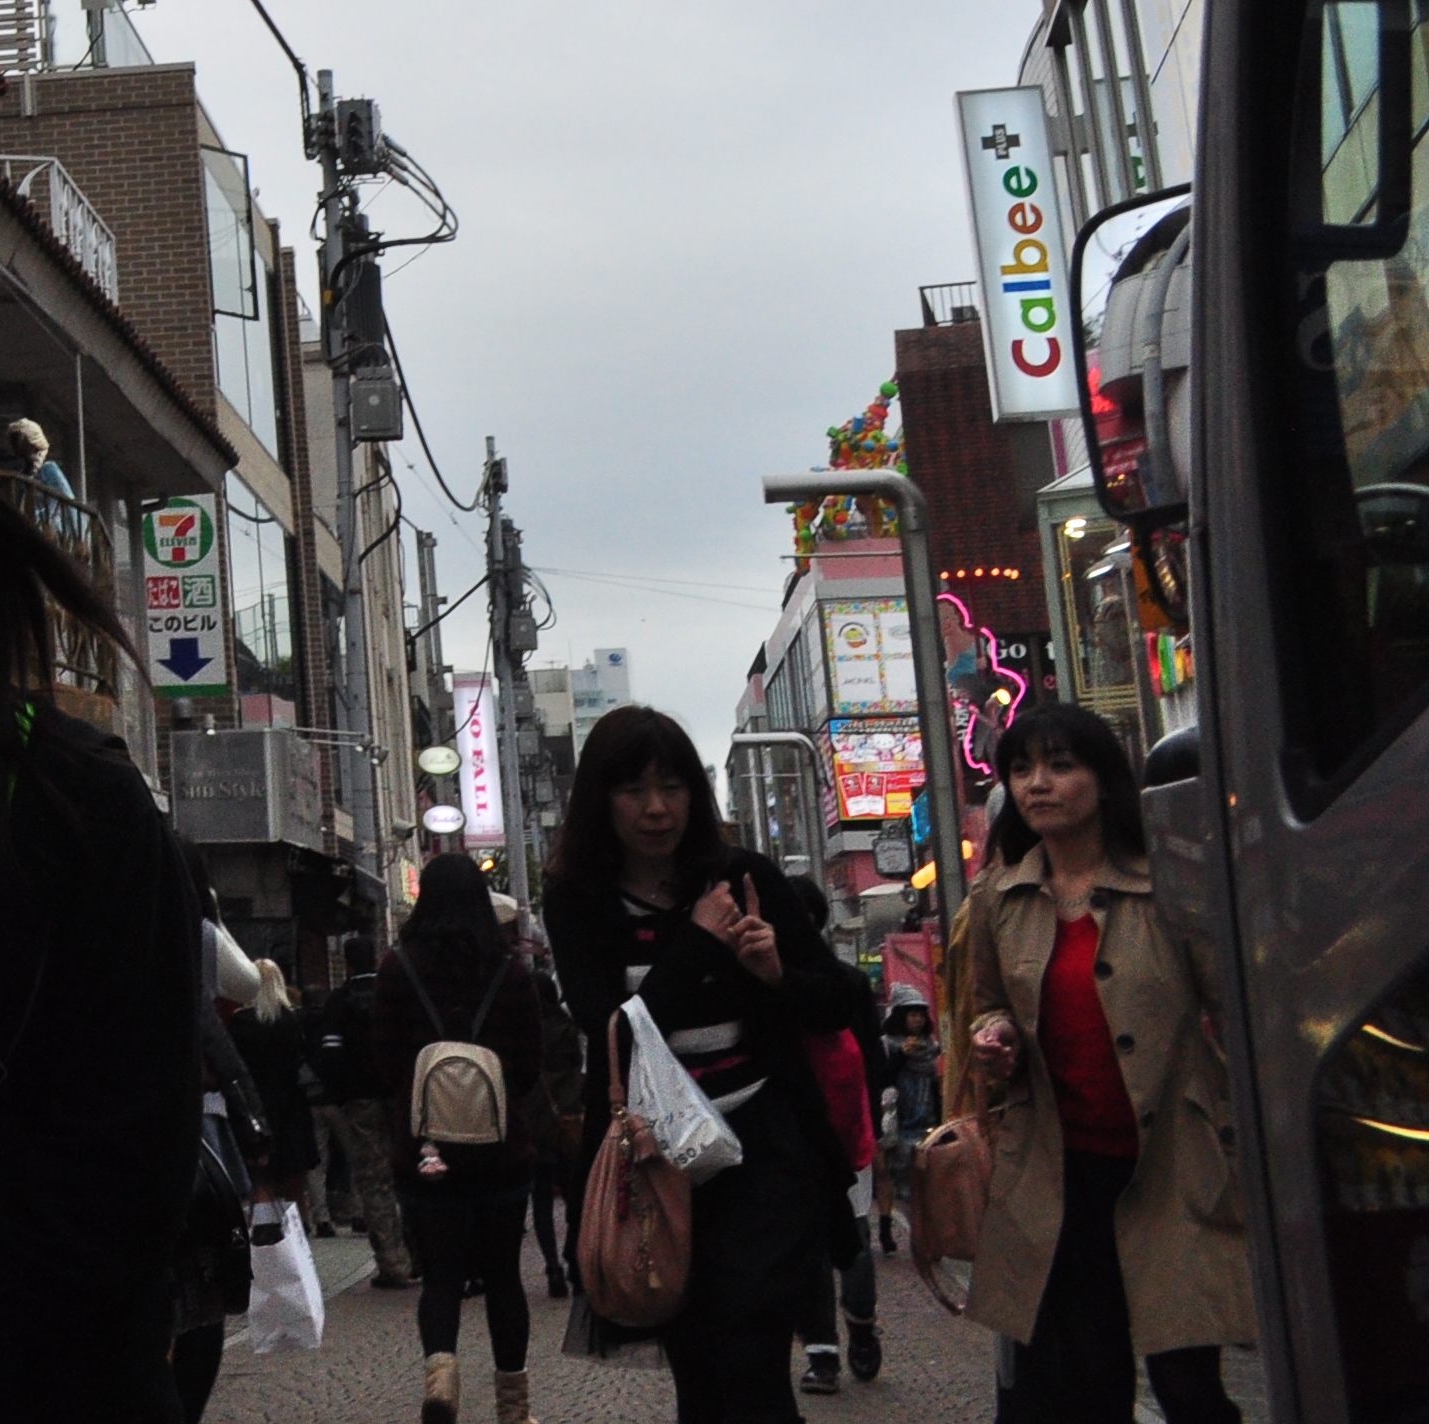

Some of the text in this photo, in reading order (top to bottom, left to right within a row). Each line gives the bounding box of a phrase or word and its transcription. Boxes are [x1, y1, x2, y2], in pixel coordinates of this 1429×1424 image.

[995, 127, 1062, 378] Calbee PLUS
[184, 578, 214, 608] 酒
[148, 614, 218, 634] このビル
[986, 639, 1028, 661] Go
